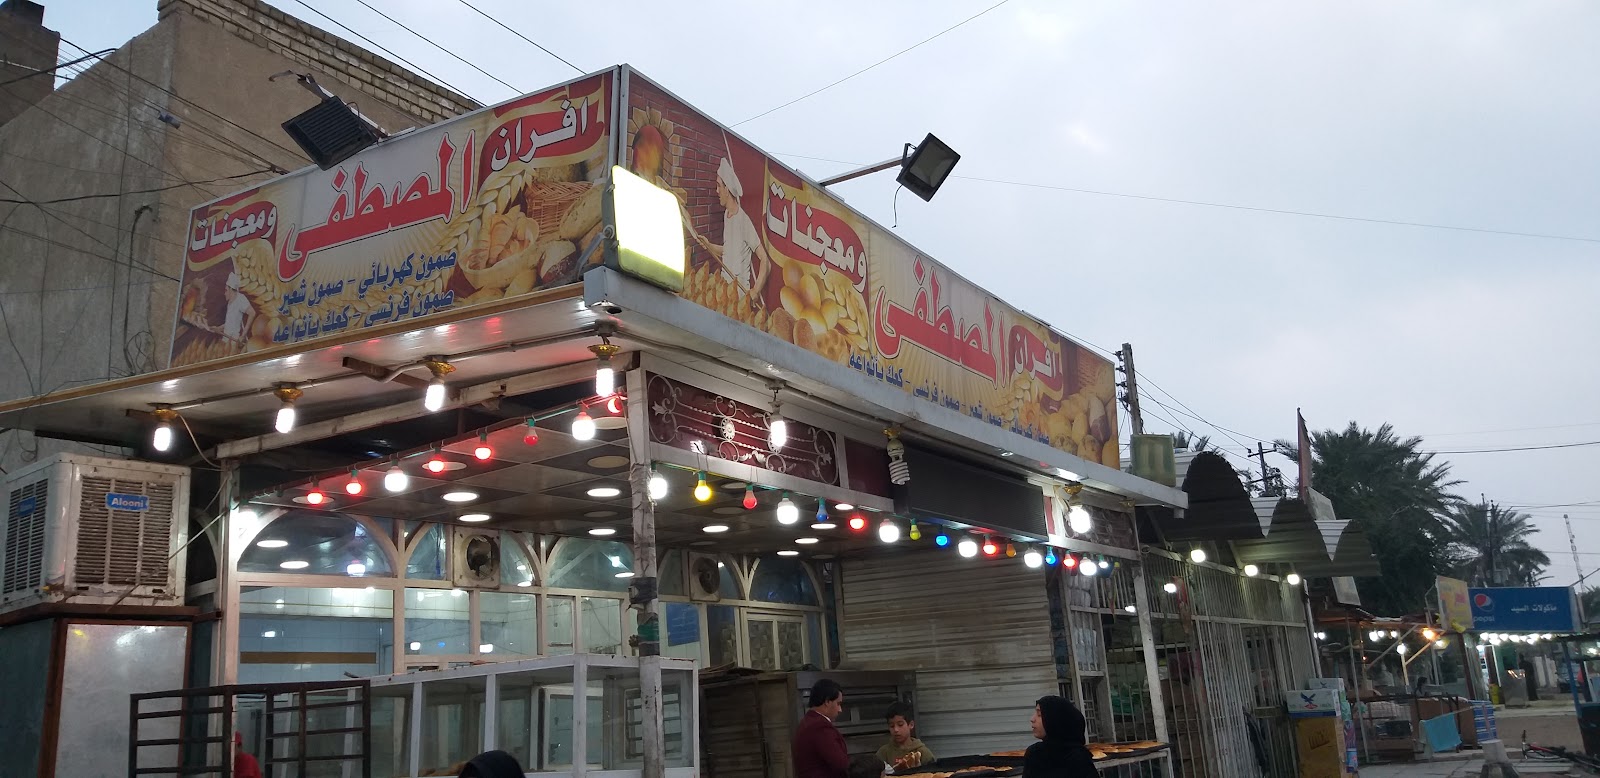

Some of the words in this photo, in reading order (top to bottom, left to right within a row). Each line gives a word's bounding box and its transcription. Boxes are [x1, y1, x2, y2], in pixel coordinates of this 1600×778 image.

[491, 98, 590, 171] افران
[278, 129, 476, 282] المصطفى
[191, 205, 277, 251] ومعجنات
[766, 182, 868, 291] ومعجنات
[358, 252, 414, 299] كهربائي
[415, 250, 457, 281] صمون
[279, 279, 306, 314] شعير
[307, 279, 343, 307] صمون
[412, 290, 454, 317] صمون
[321, 305, 350, 332] كعك
[873, 255, 1010, 389] المصطفى
[1014, 335, 1057, 381] افران
[886, 365, 903, 387] كعك
[940, 389, 960, 411] صمون
[111, 497, 144, 508] Alooni
[1474, 615, 1495, 624] pepsi
